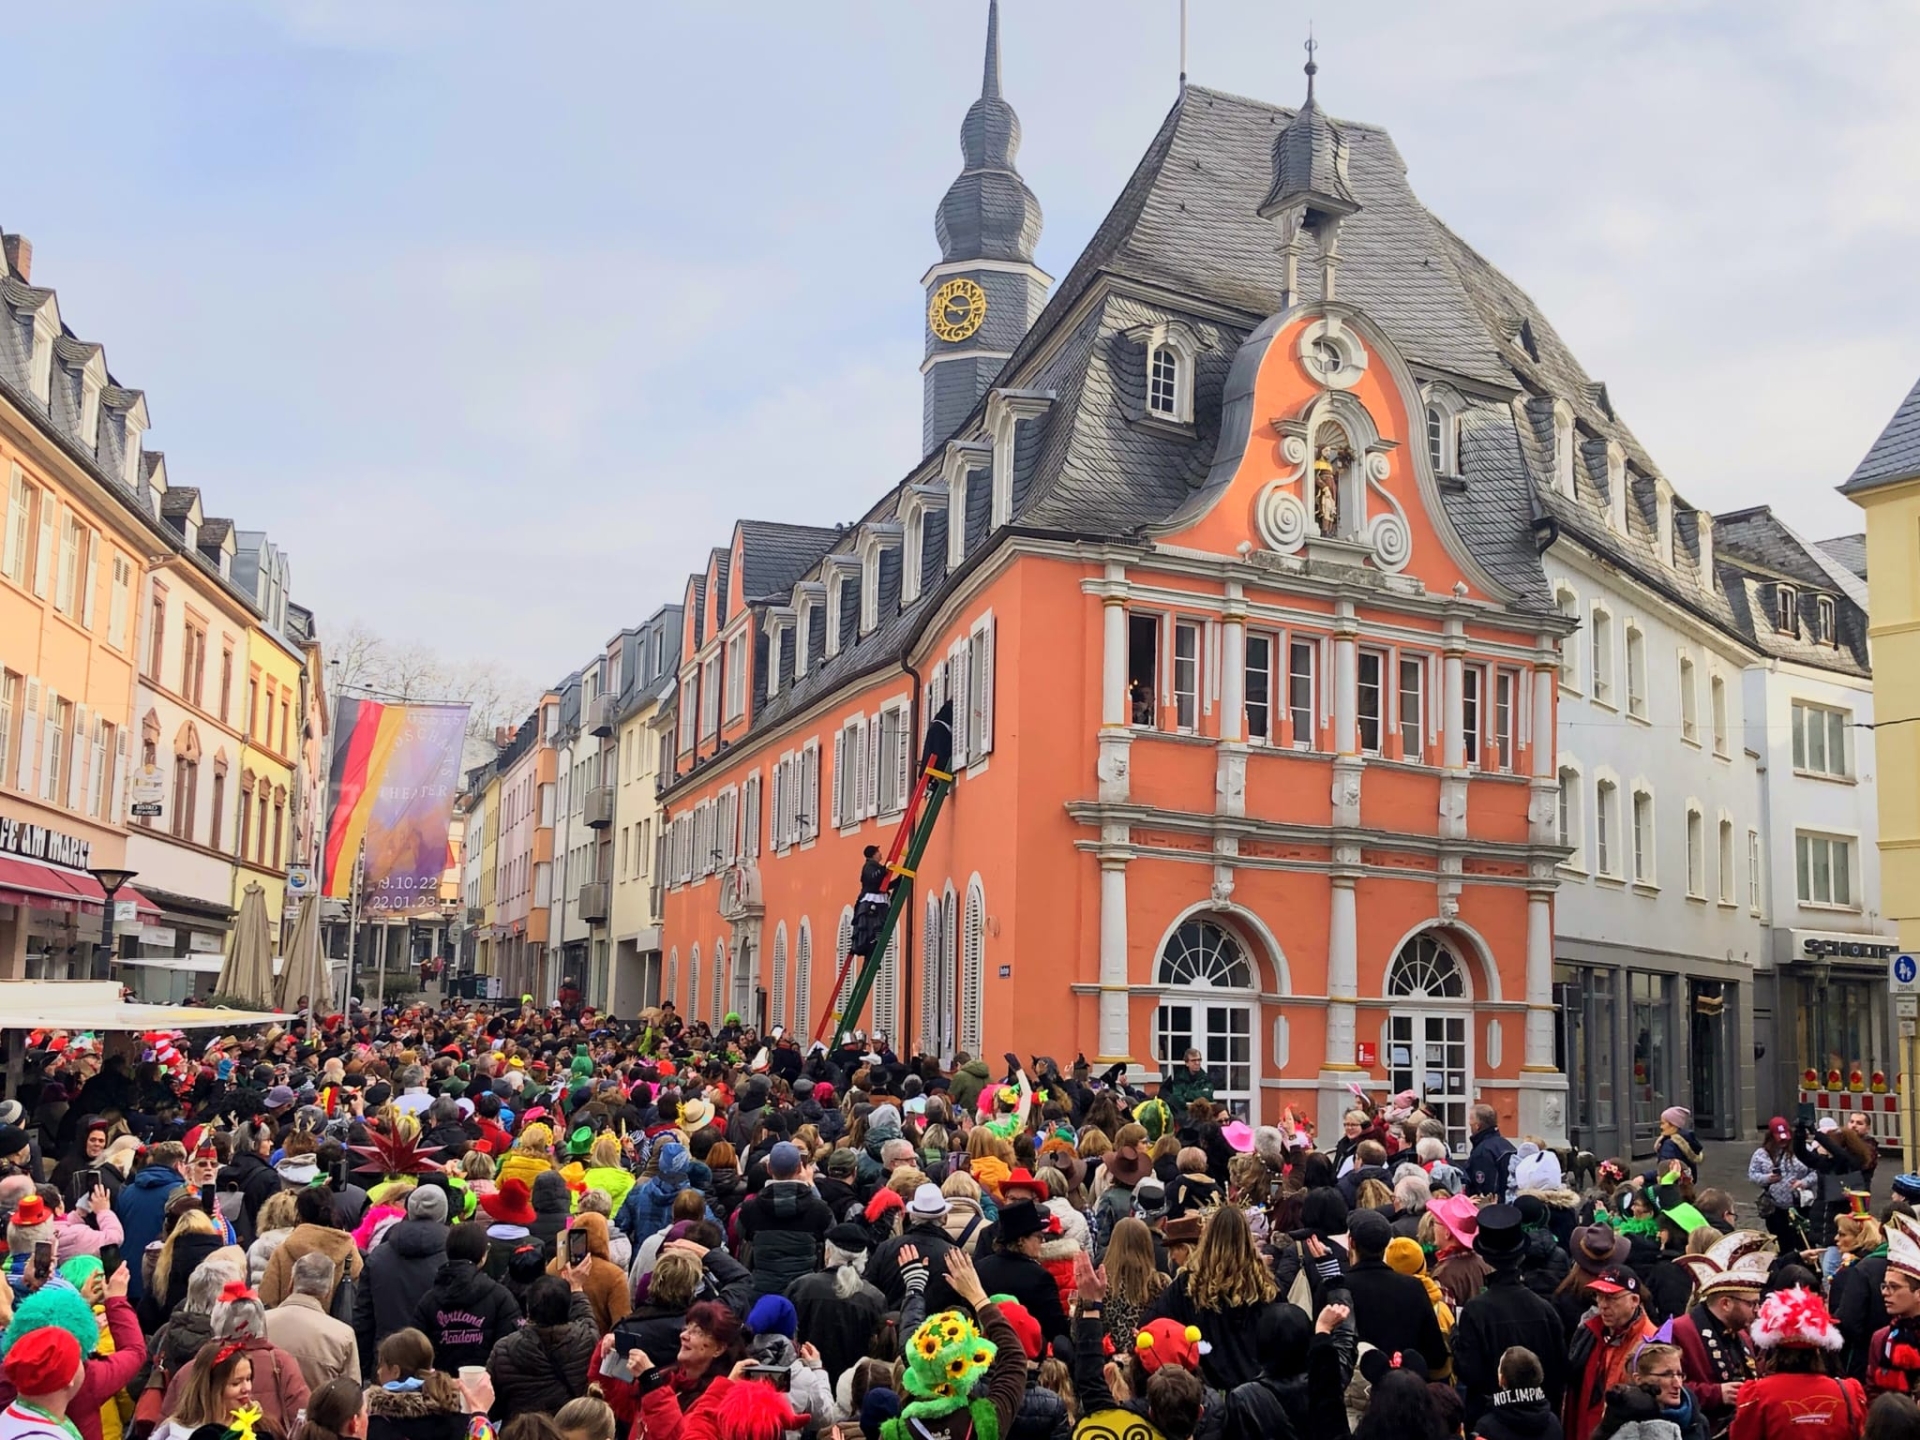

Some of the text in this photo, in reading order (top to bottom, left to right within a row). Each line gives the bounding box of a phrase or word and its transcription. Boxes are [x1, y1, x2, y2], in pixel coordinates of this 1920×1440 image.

[407, 711, 461, 725] OSSES
[21, 822, 46, 858] AM
[378, 876, 438, 890] 9.10.22
[373, 895, 436, 909] 22.01.23
[440, 1329, 484, 1345] Academy
